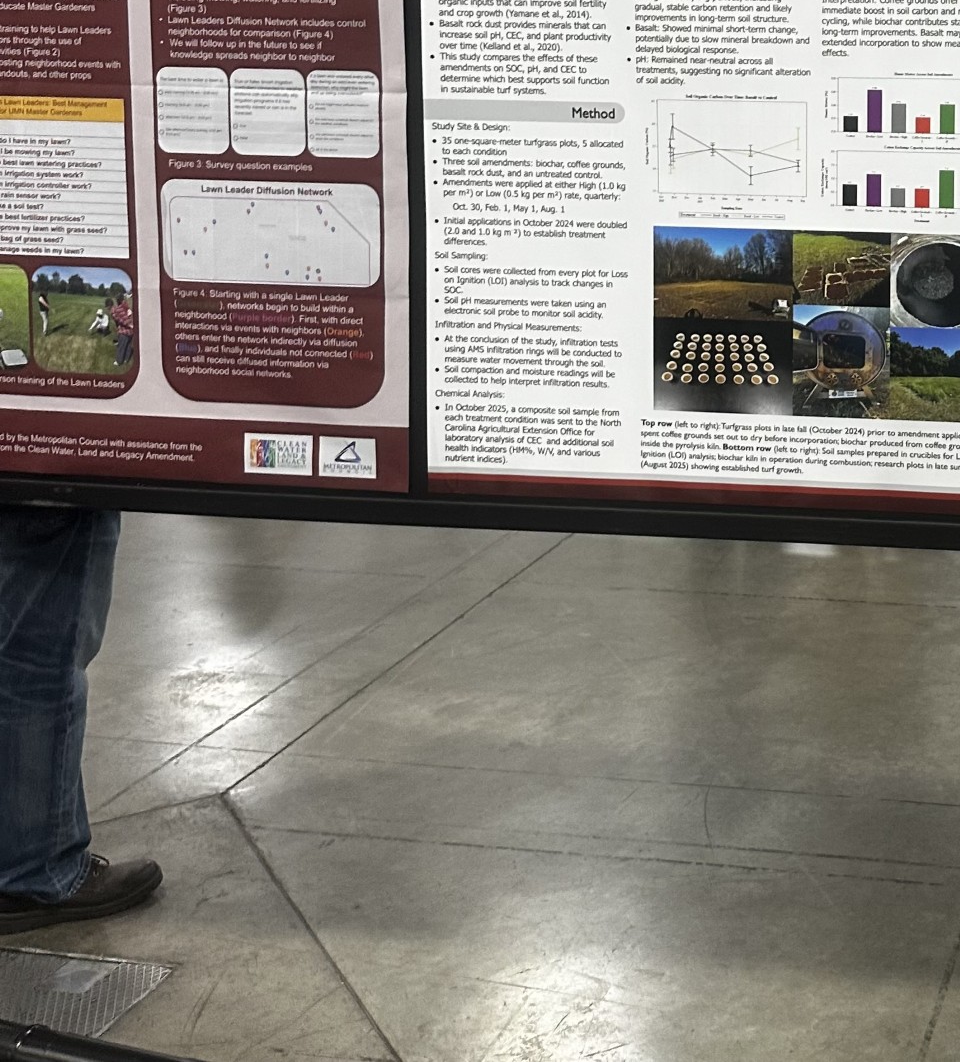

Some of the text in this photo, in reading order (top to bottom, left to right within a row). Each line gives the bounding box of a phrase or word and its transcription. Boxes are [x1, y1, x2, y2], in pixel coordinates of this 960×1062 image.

[572, 107, 616, 120] Method
[432, 122, 510, 133] Study Site & Design:
[169, 159, 195, 170] Figure
[206, 160, 234, 171] Survey
[236, 162, 271, 171] question
[273, 163, 313, 173] examples
[201, 185, 333, 196] Lawn Leader Diffusion Network
